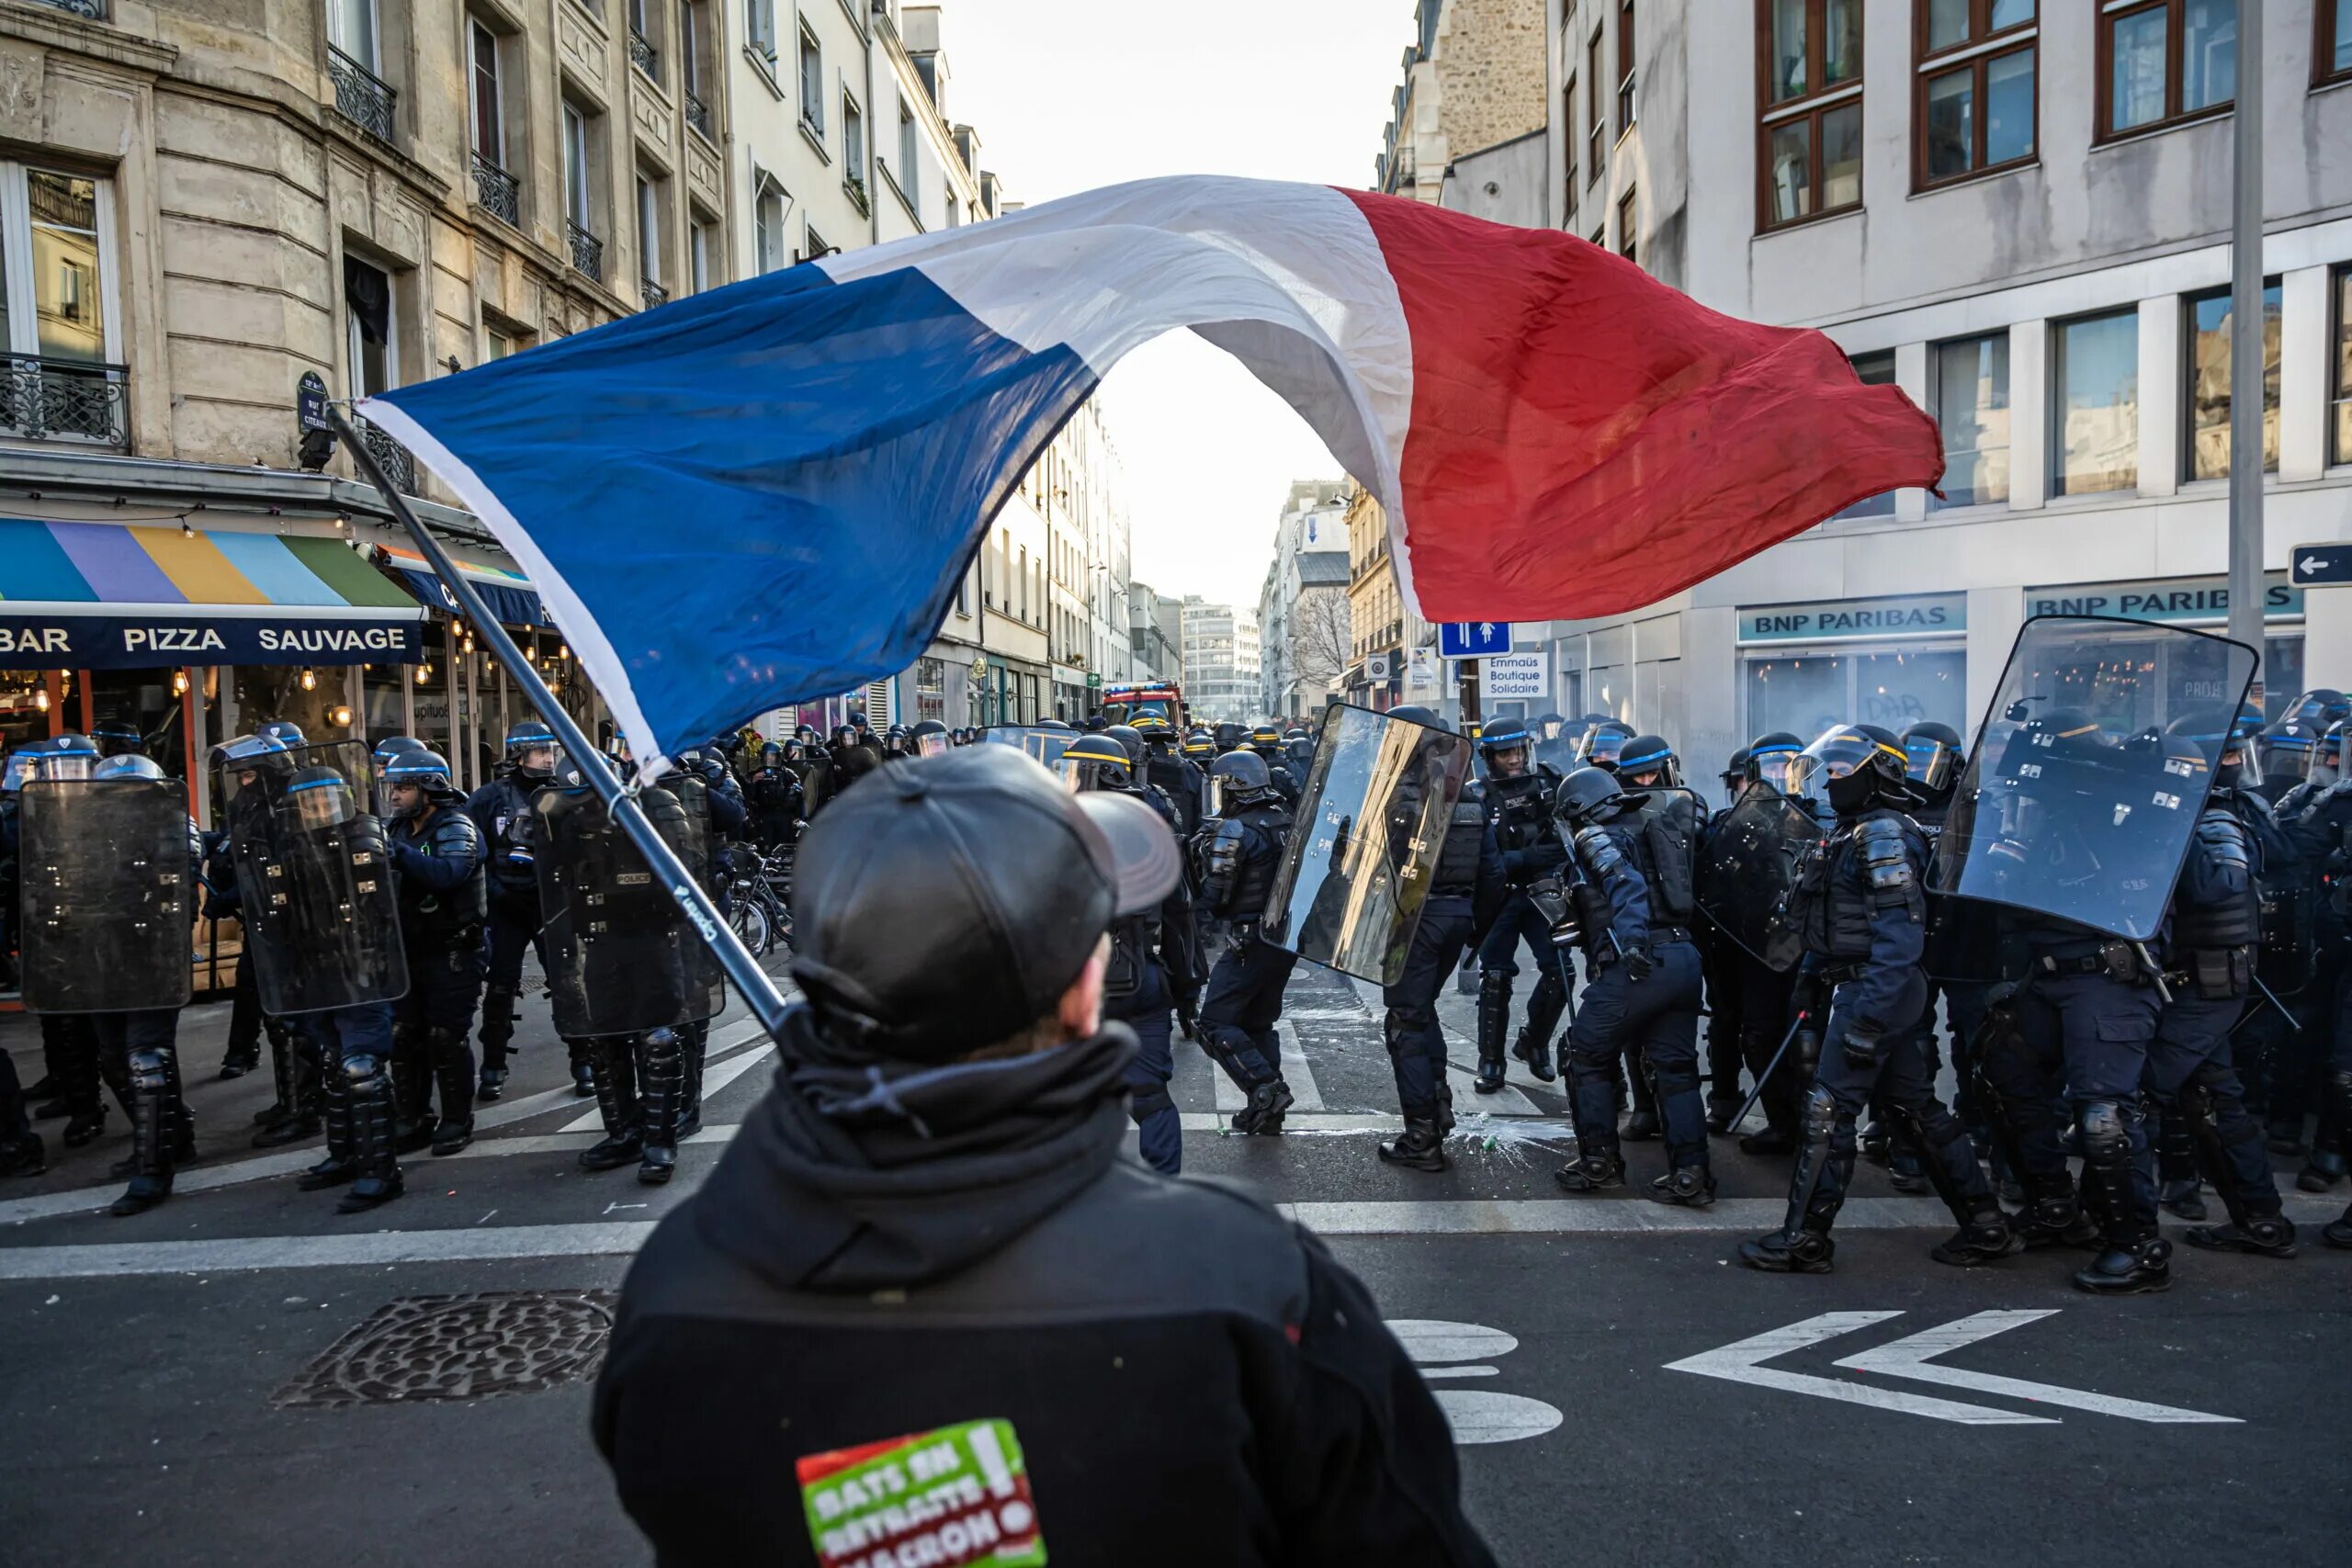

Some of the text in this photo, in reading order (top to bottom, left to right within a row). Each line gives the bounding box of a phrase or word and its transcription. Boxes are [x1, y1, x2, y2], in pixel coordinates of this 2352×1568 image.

[2035, 585, 2290, 615] BNP PARIBS
[1755, 606, 1947, 633] BNP PARIBAS
[0, 628, 406, 652] BAR PIZZA SAUVAGE
[1490, 658, 1538, 668] Emmaüs
[1490, 671, 1540, 682] Boutique
[1490, 684, 1539, 694] Solidaire
[617, 874, 650, 883] POLICE
